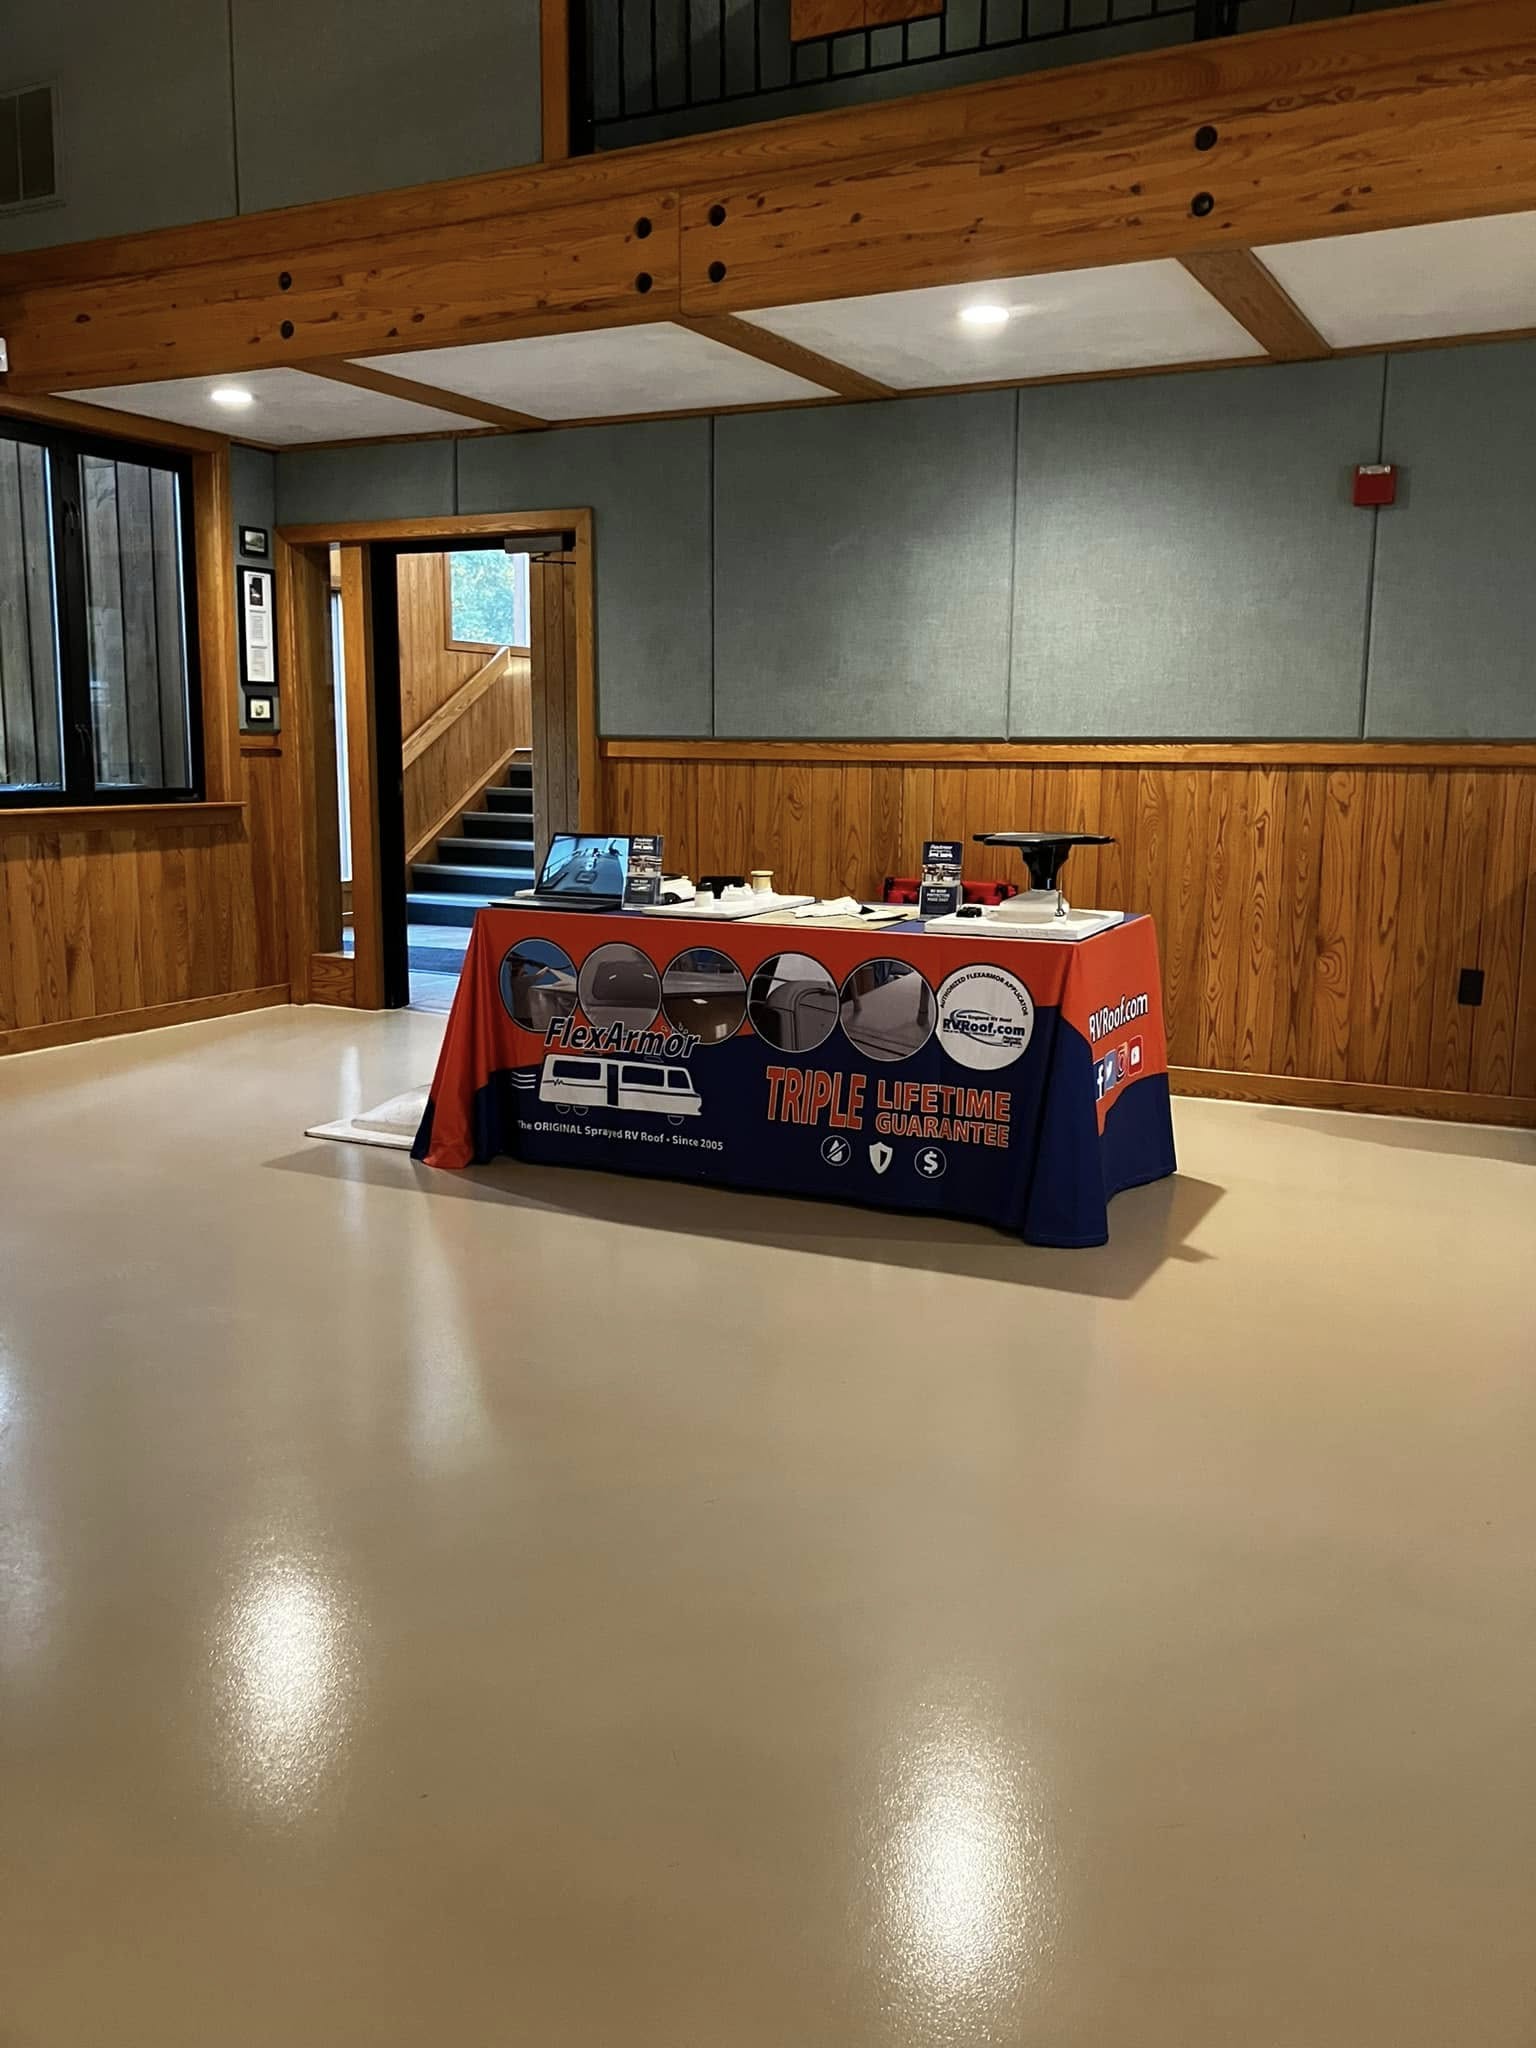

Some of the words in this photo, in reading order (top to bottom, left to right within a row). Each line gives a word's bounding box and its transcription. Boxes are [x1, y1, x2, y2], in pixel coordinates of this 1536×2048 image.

[940, 976, 966, 1008] AUTHORIZED
[966, 972, 1004, 983] FLEXARMOR
[1004, 980, 1028, 1016] APPLICATOR
[544, 1016, 700, 1057] FlexArmor
[943, 1018, 1025, 1036] RVRoof.com
[1089, 992, 1148, 1042] RVRoof.com
[766, 1065, 867, 1130] TRIPLE
[877, 1079, 1012, 1122] LIFETIME
[517, 1120, 532, 1130] The
[534, 1121, 582, 1135] ORIGINAL
[585, 1126, 623, 1139] Sprayed
[625, 1130, 639, 1140] RV
[641, 1132, 664, 1143] Roof
[672, 1135, 699, 1147] Since
[700, 1138, 724, 1151] 2005
[875, 1112, 1010, 1148] GUARANTEE
